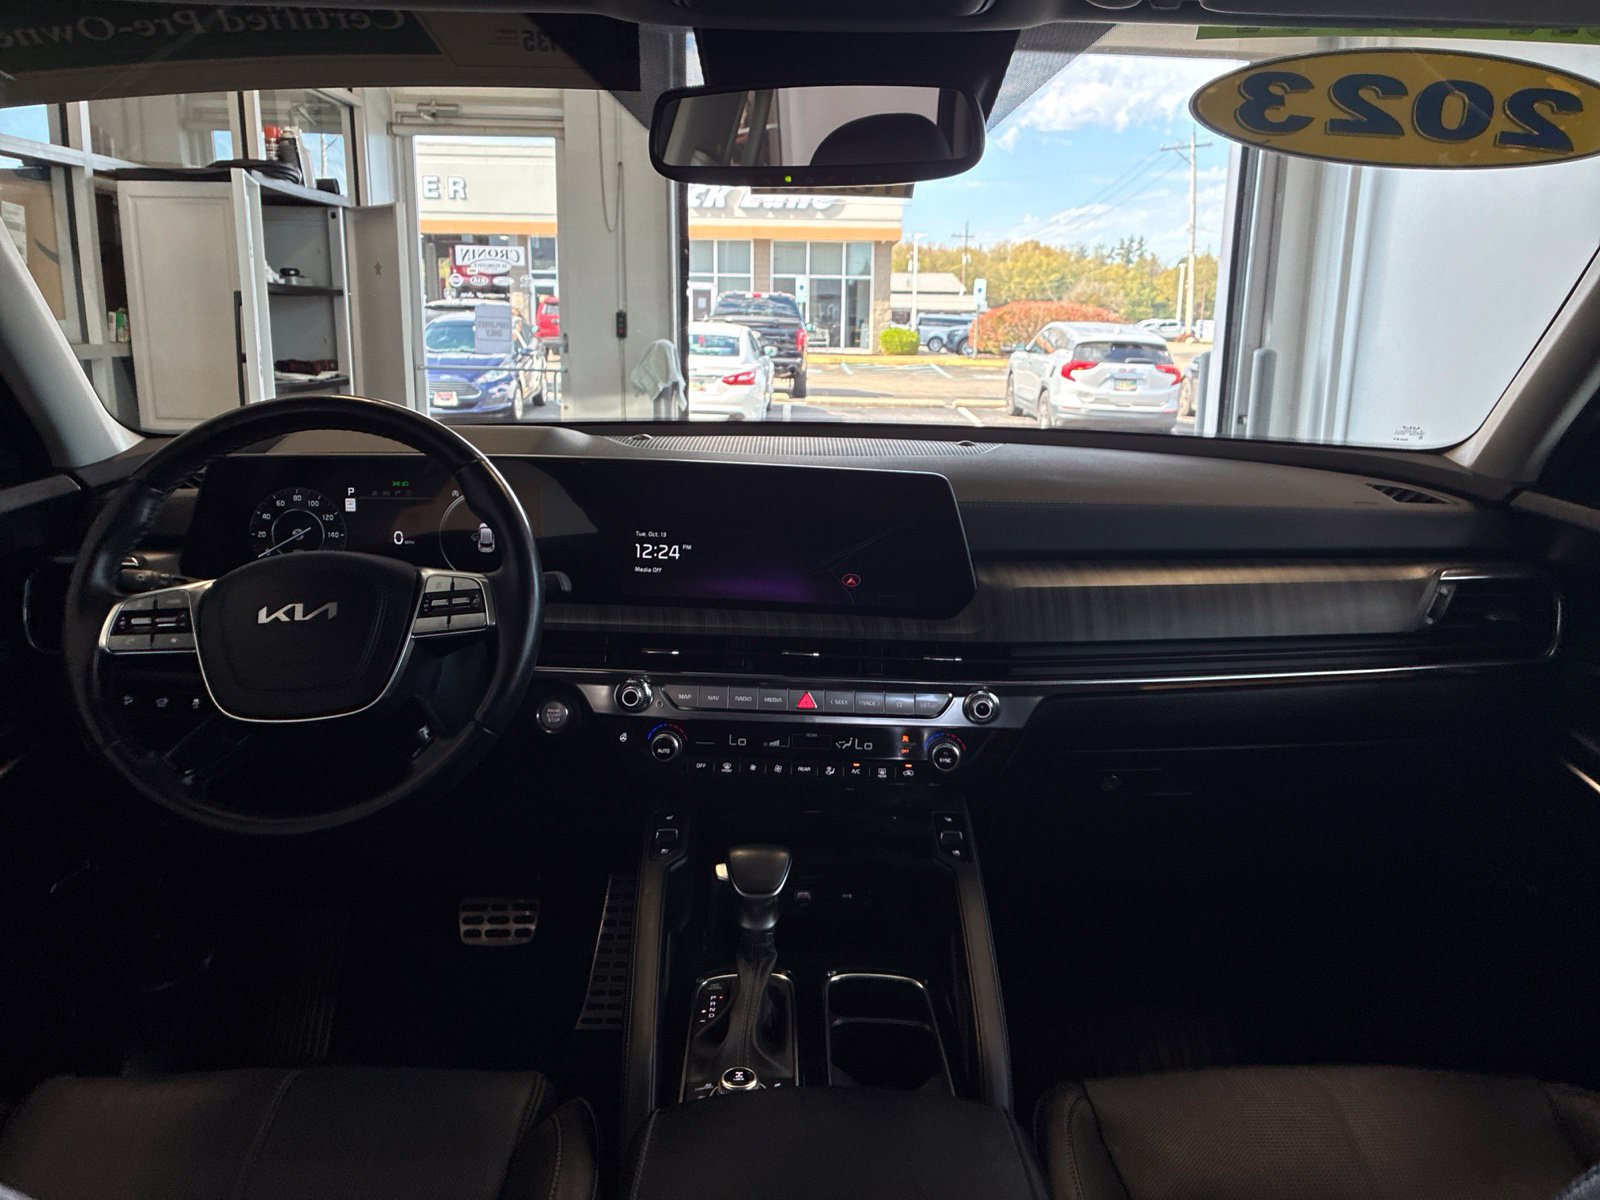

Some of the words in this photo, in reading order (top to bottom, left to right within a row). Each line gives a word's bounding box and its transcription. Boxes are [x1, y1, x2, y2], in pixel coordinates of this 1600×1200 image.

[292, 494, 303, 502] 80
[347, 487, 355, 496] P
[393, 530, 404, 545] 0
[635, 543, 680, 560] 12:24
[257, 601, 338, 625] KIA
